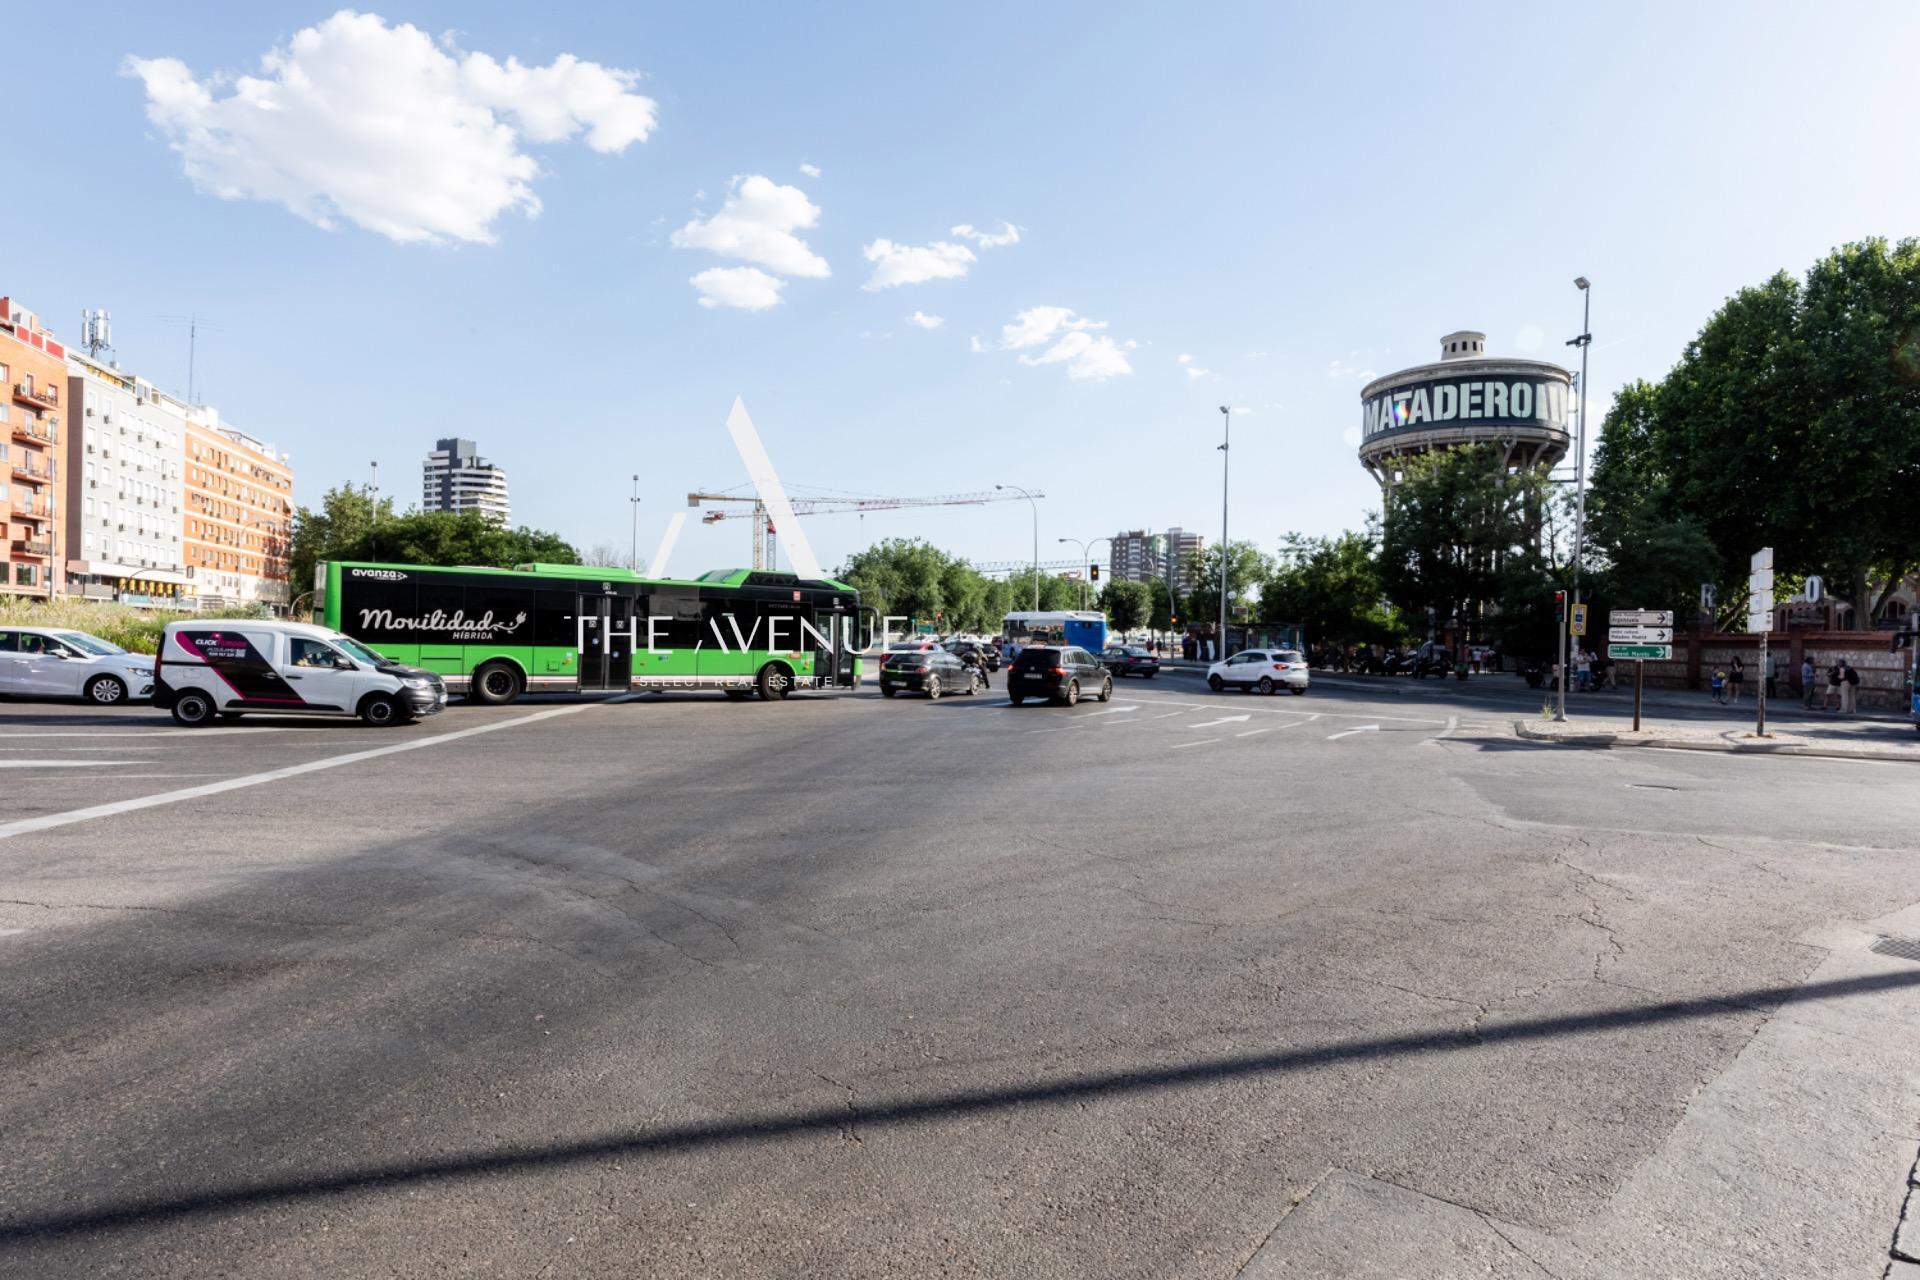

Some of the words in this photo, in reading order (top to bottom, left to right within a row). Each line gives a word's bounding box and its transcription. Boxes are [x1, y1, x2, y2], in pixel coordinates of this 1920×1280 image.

[1364, 381, 1532, 437] MATADERO
[352, 568, 397, 578] avanza
[359, 608, 494, 631] Movilidad
[453, 631, 493, 640] HÍBRIDA
